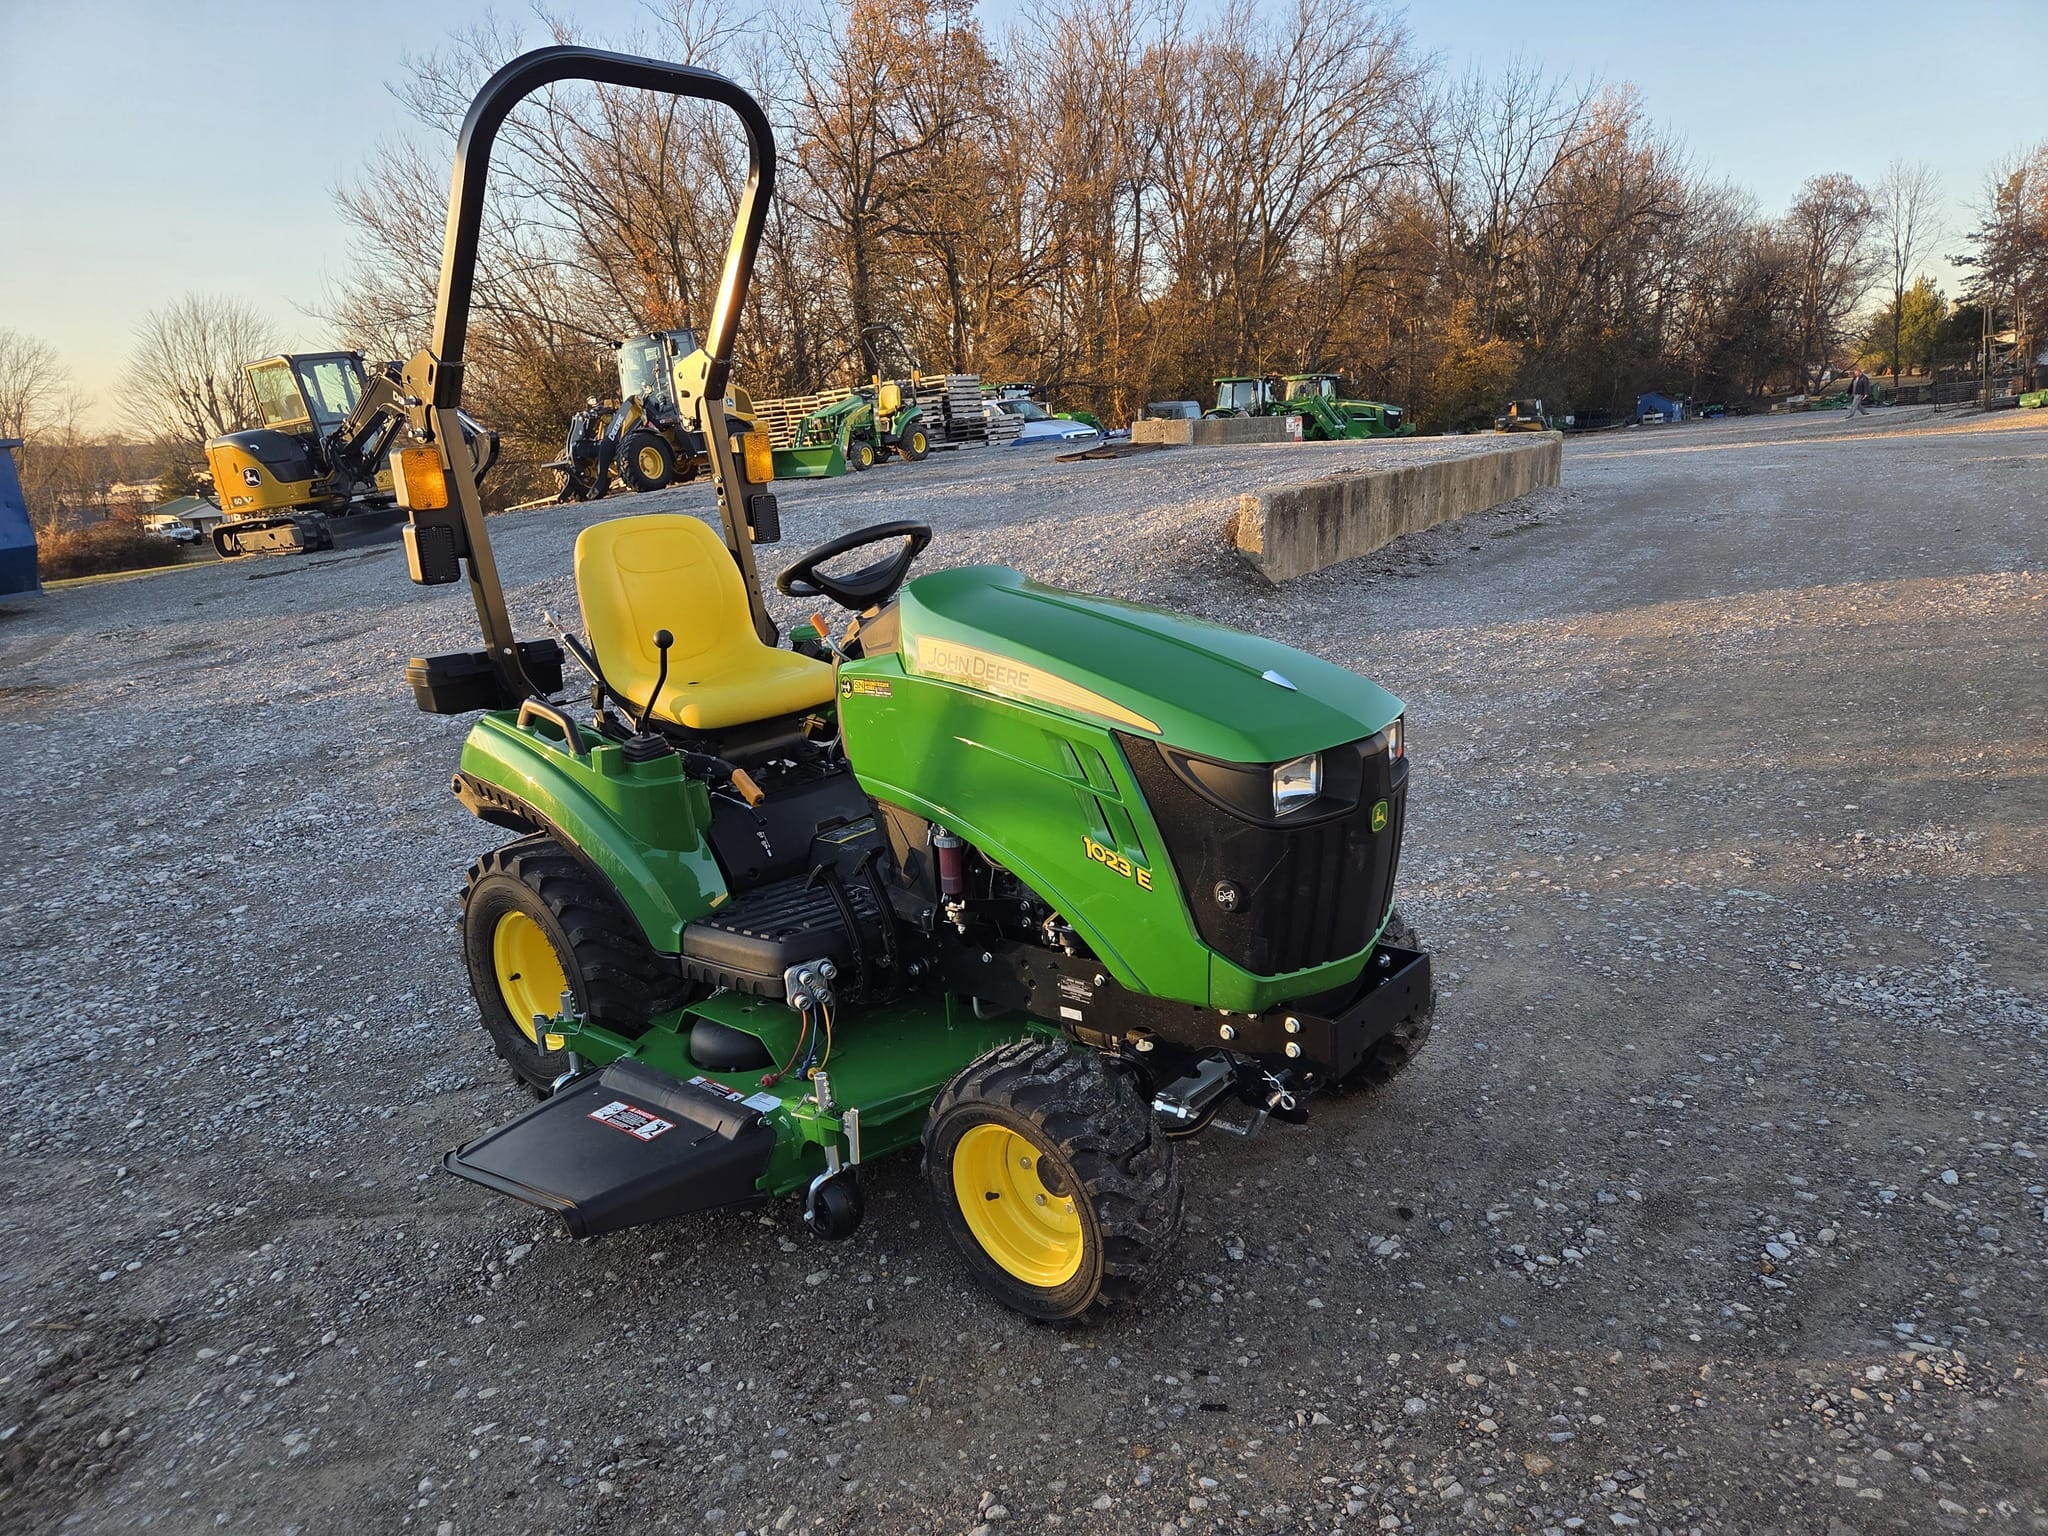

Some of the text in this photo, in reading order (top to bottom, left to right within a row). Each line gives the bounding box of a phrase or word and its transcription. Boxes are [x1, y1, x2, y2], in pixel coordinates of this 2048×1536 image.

[608, 413, 625, 441] DEERE
[927, 647, 1031, 689] JOHN DEERE
[1081, 835, 1153, 892] 1023 E
